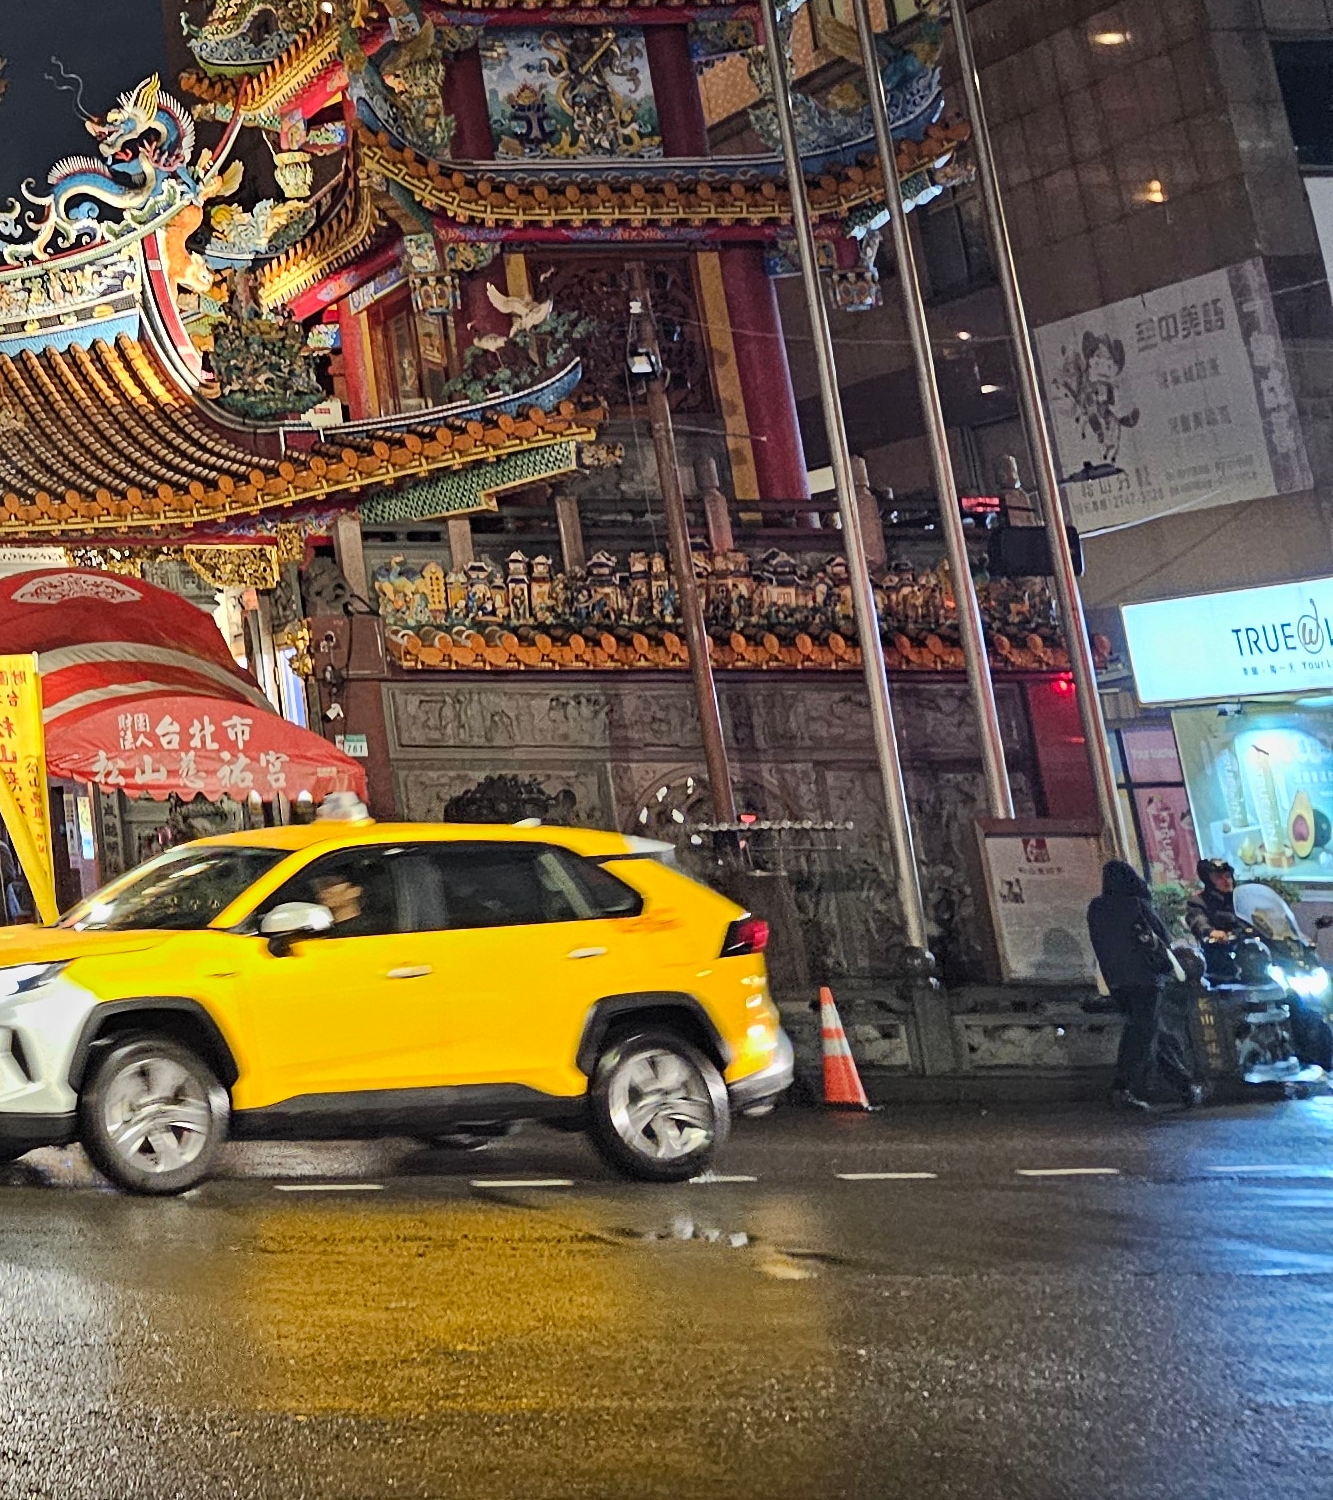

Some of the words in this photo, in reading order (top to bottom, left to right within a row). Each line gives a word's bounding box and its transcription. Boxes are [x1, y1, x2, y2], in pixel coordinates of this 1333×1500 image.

[155, 714, 253, 750] 台北市
[91, 750, 290, 788] 松山慈祐宮
